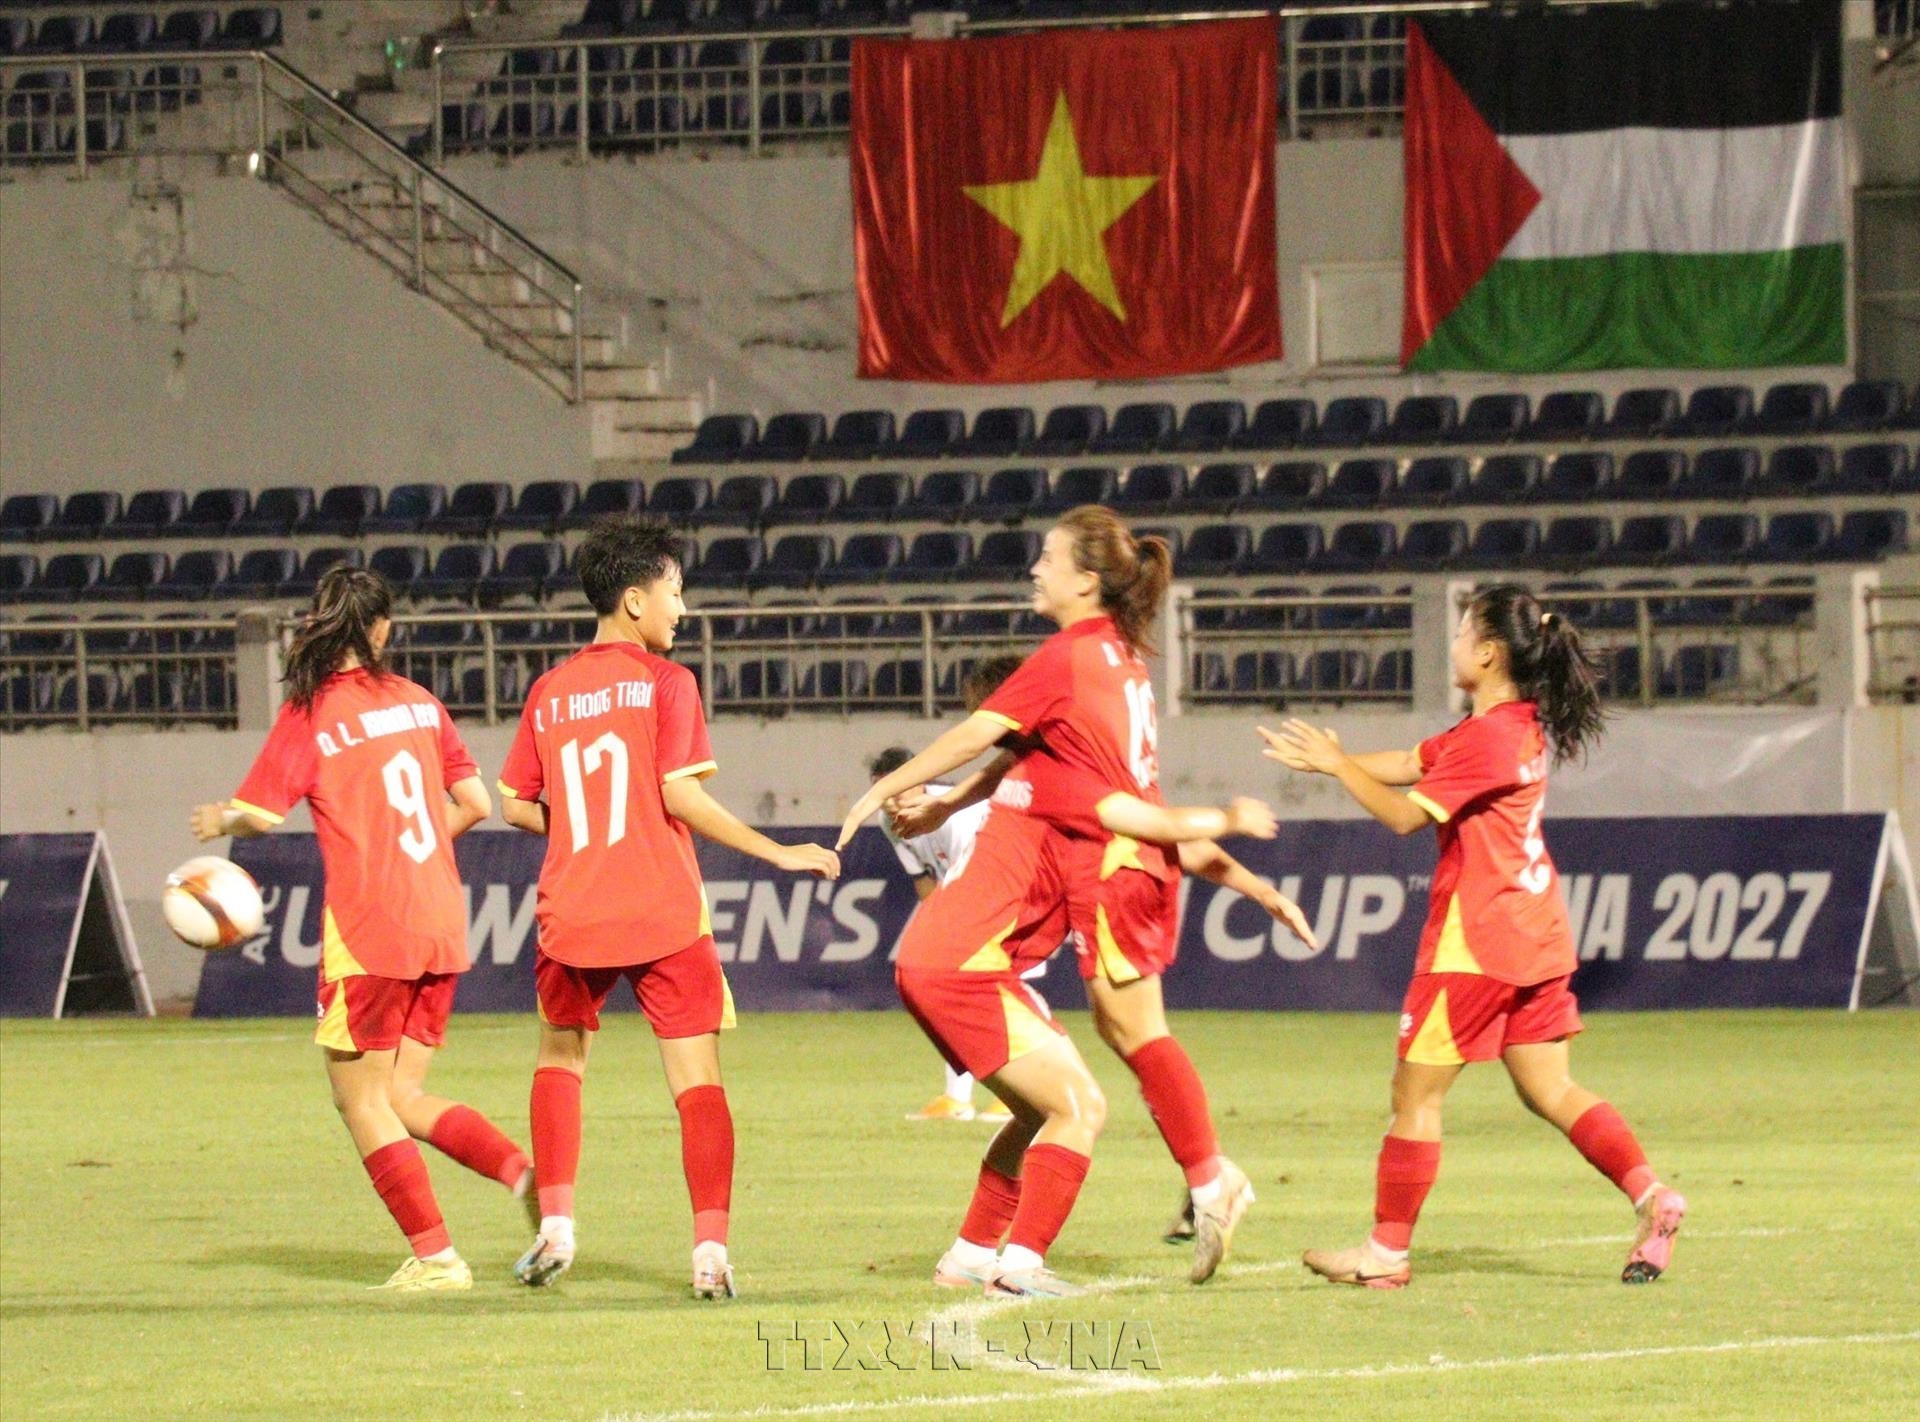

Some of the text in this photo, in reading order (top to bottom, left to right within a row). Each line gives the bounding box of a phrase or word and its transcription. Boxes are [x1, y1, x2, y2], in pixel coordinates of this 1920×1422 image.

[381, 749, 438, 865] 9
[560, 730, 629, 855] 17
[1643, 870, 1832, 961] 2027
